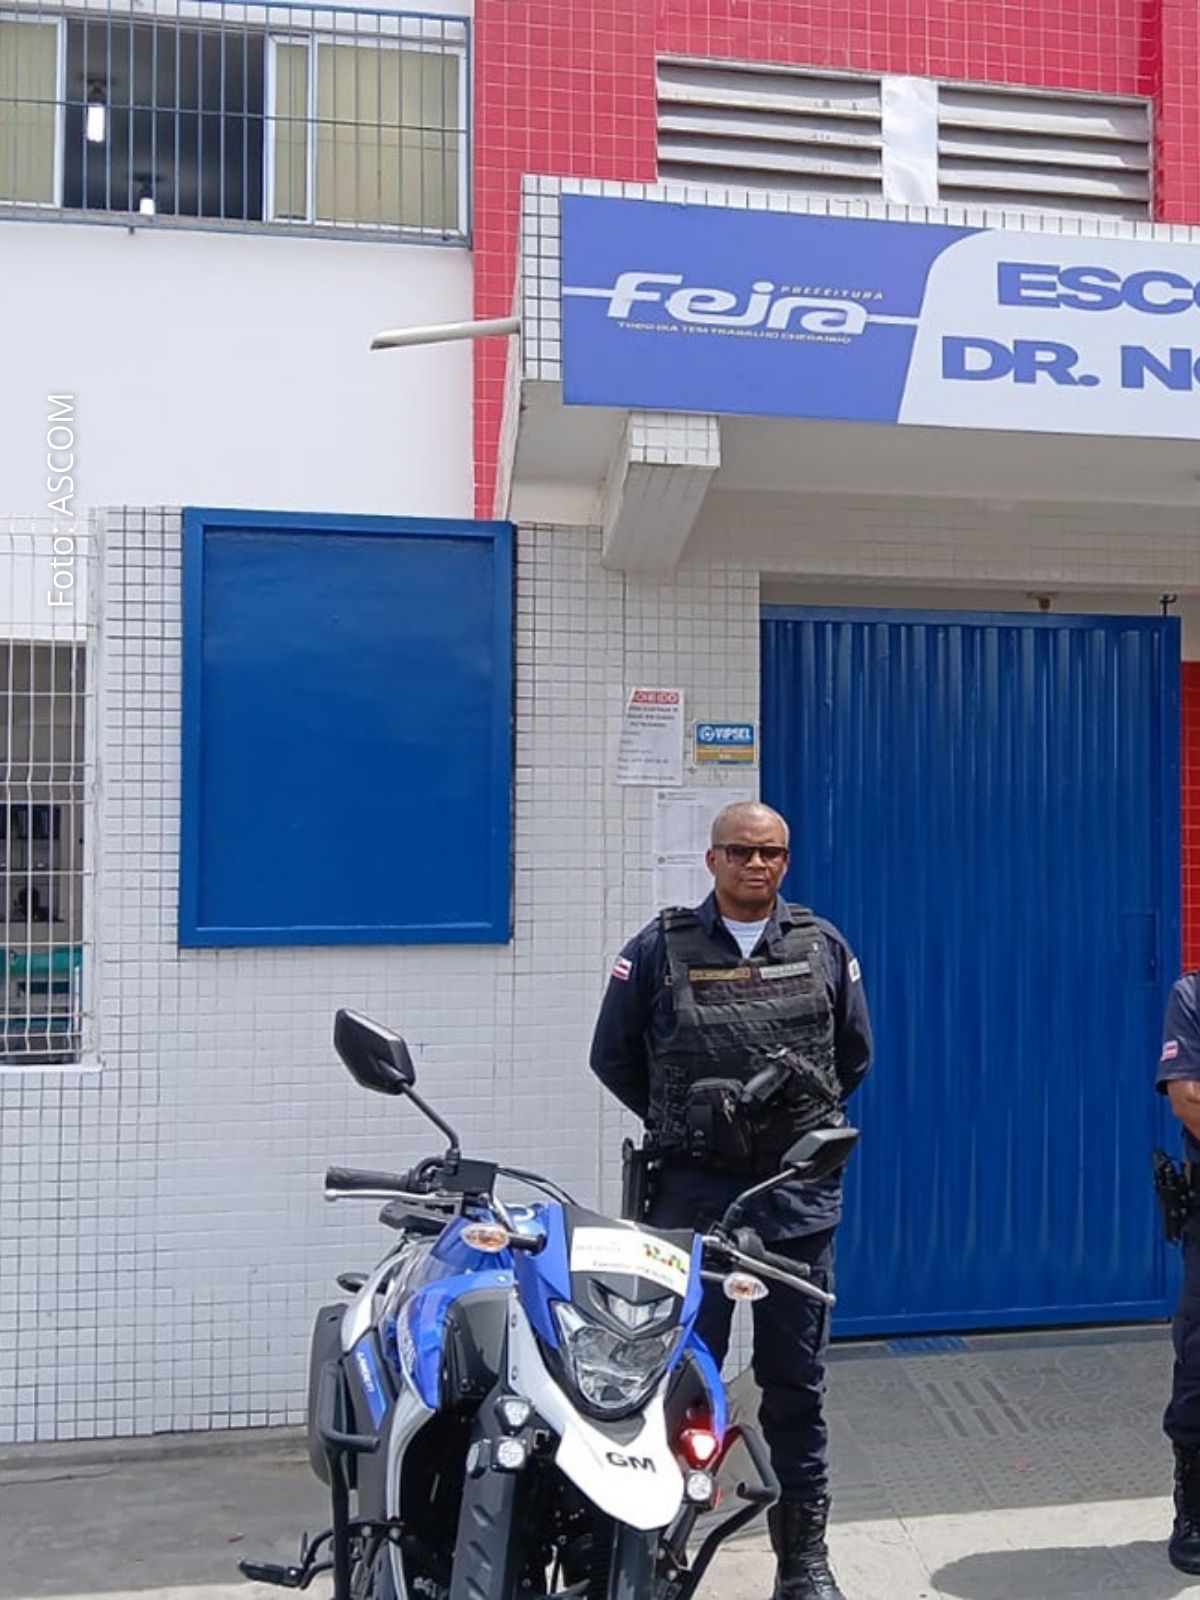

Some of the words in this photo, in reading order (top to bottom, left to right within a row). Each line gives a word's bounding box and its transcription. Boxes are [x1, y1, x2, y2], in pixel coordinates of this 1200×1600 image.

[780, 285, 884, 300] PREFEITURA
[942, 336, 1100, 388] DR.
[605, 1451, 657, 1473] GM
